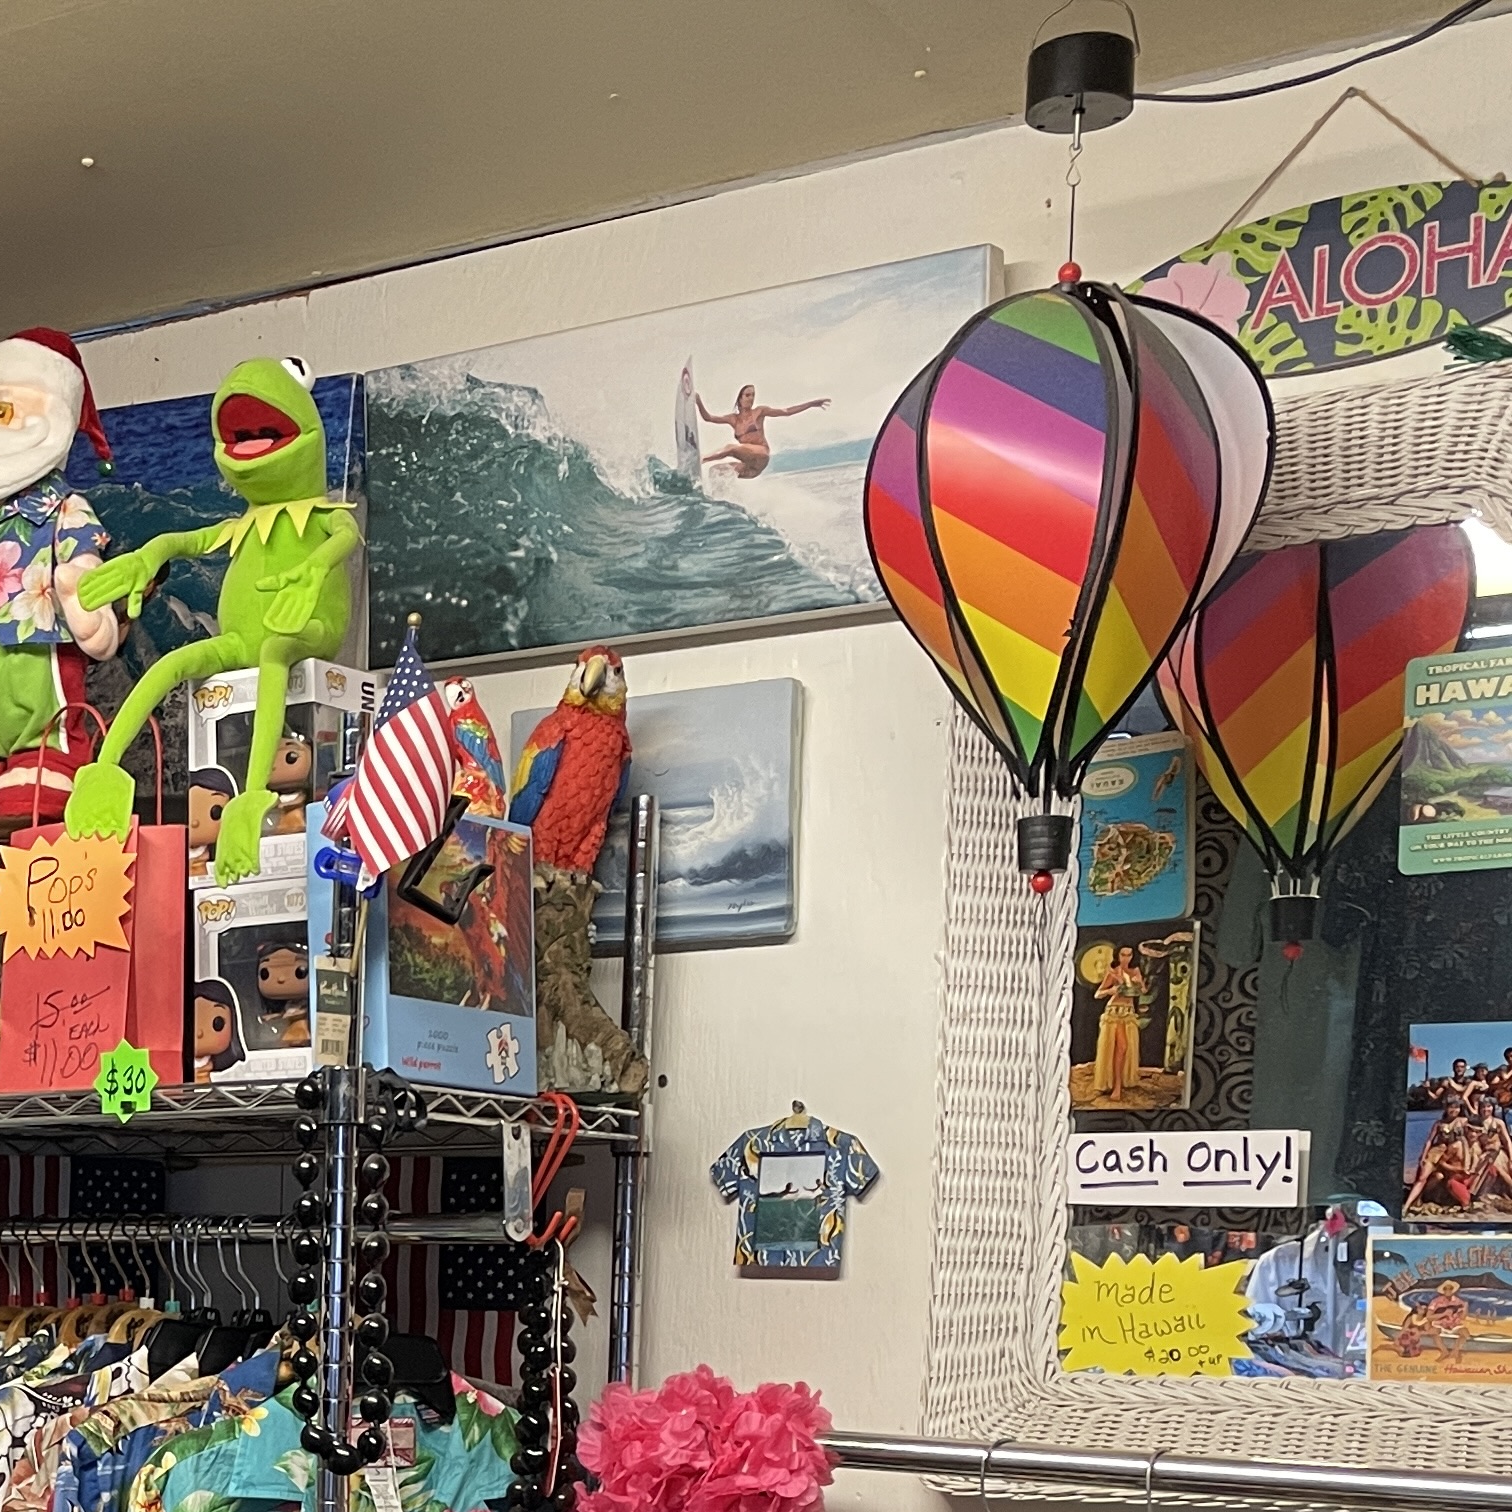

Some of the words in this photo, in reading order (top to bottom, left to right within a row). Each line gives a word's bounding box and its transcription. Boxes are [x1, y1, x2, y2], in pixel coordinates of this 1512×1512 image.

[1428, 661, 1487, 675] TROPICAL
[192, 685, 233, 713] POP!
[197, 900, 236, 924] POP!
[104, 1058, 146, 1099] $30
[1075, 1138, 1168, 1174] Cash
[1187, 1136, 1293, 1191] Only!
[1374, 1364, 1392, 1374] THE
